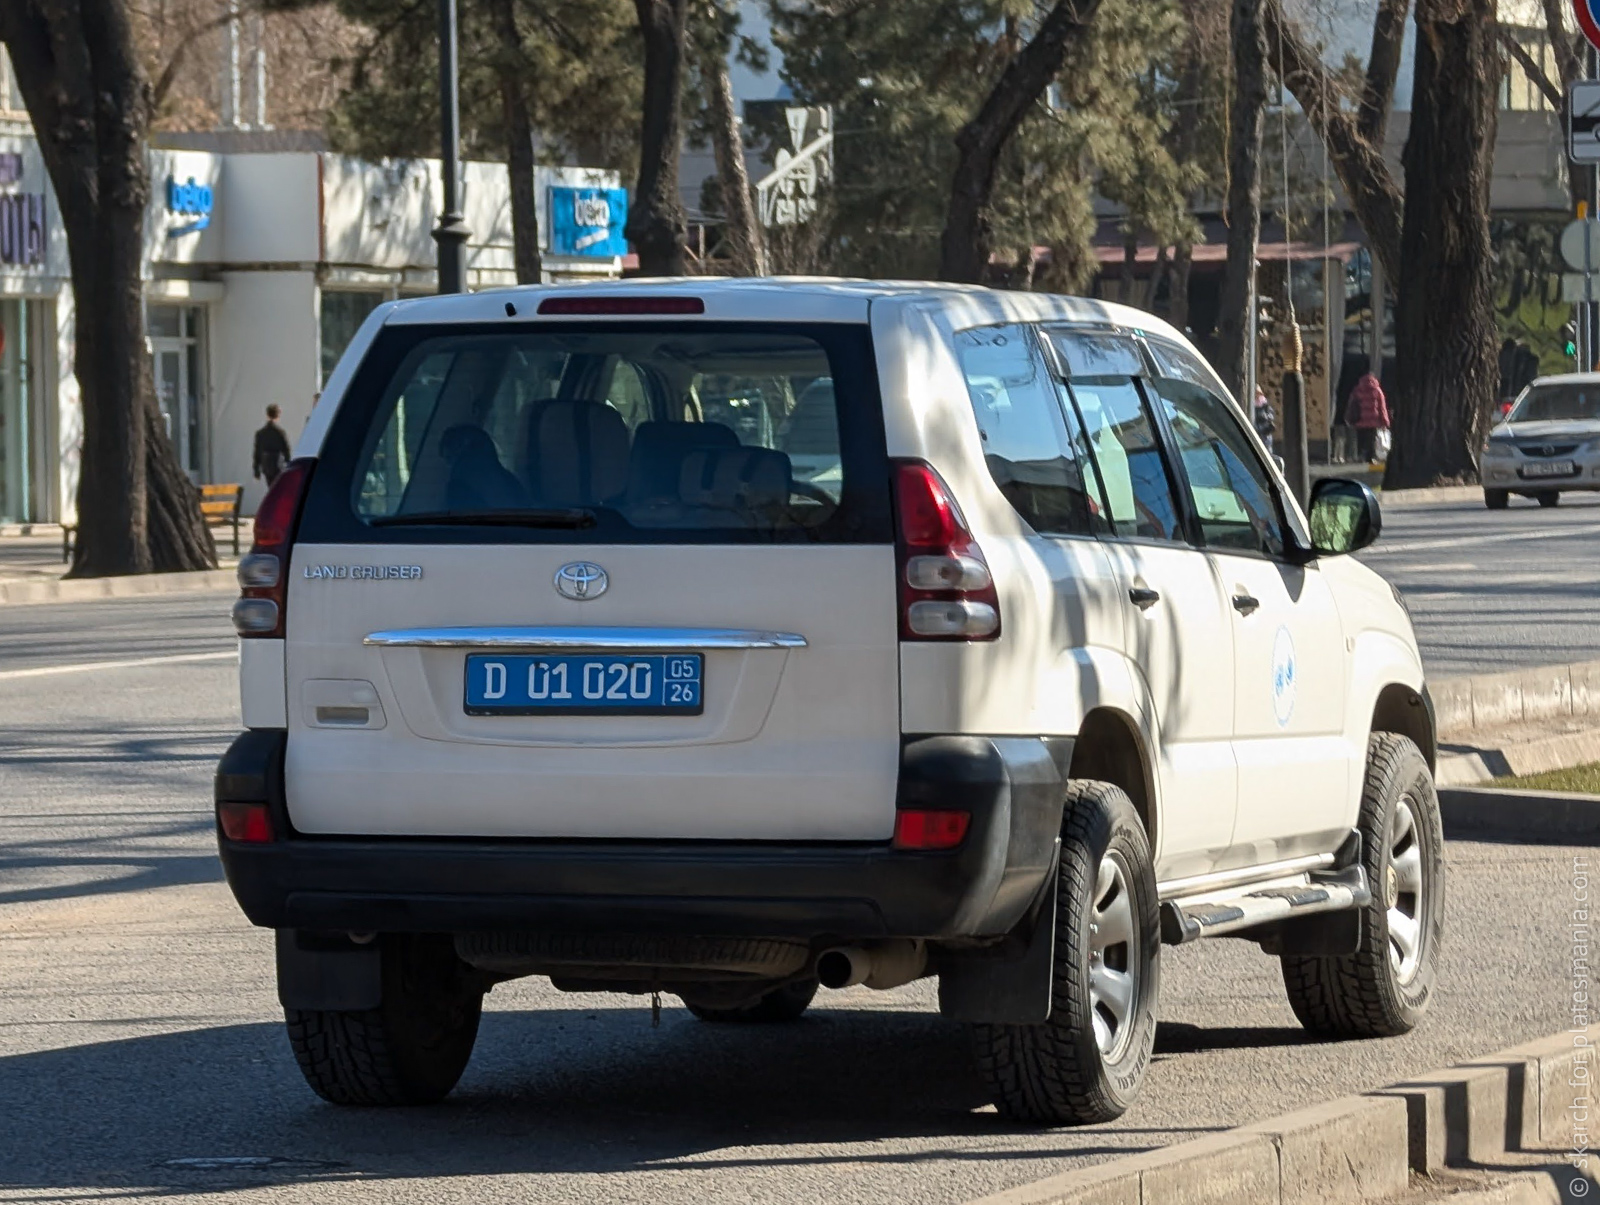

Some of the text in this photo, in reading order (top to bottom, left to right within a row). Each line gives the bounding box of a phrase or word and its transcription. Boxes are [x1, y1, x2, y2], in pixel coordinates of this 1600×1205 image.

[165, 174, 214, 215] beko
[574, 188, 610, 227] beko
[303, 565, 423, 580] LAND CRUISER
[483, 662, 652, 699] D 01 020
[671, 660, 694, 678] 05
[671, 684, 694, 702] 26
